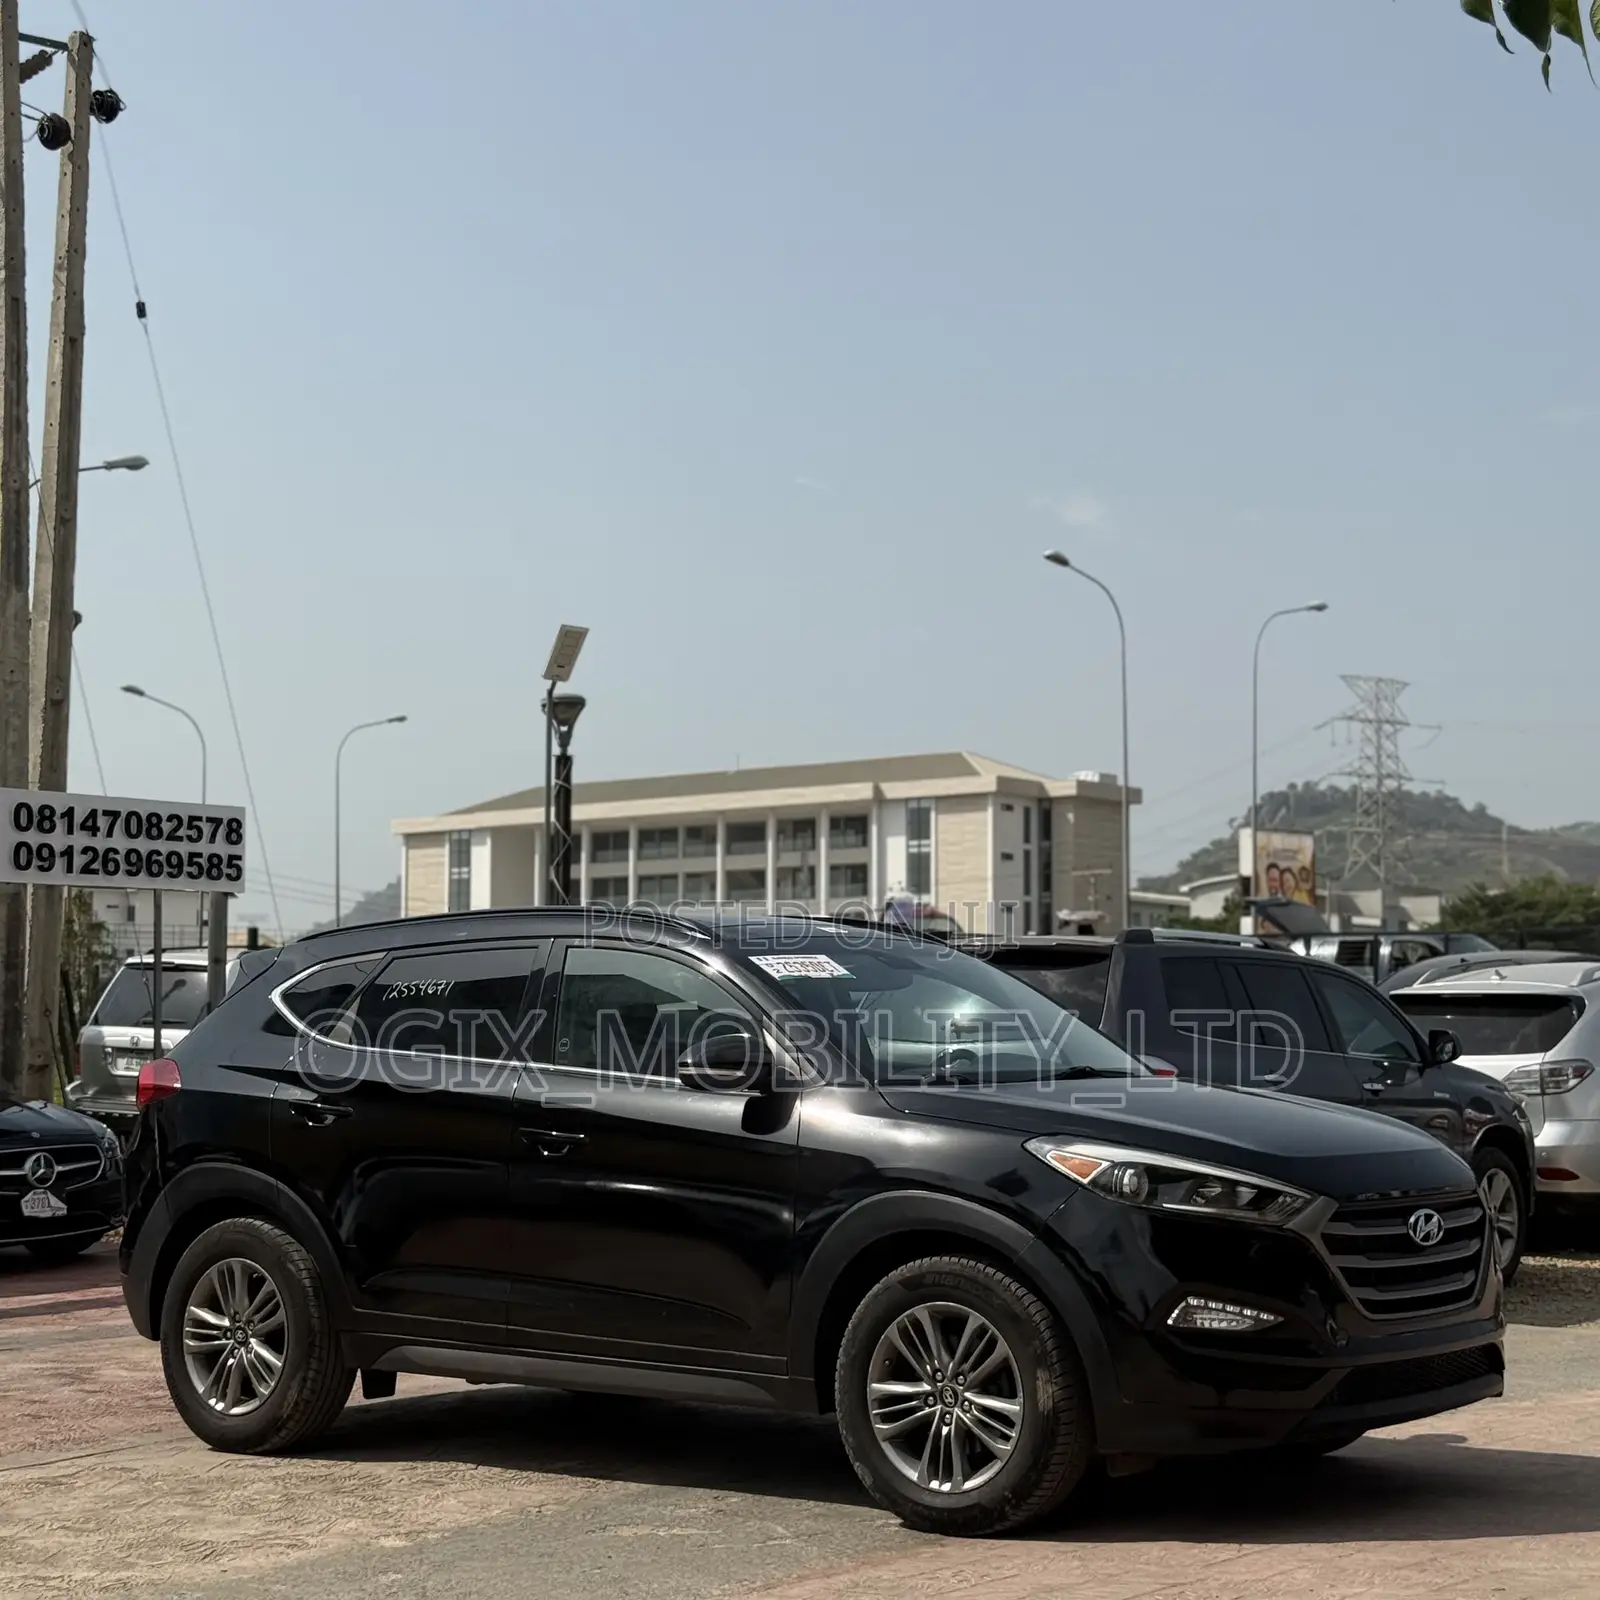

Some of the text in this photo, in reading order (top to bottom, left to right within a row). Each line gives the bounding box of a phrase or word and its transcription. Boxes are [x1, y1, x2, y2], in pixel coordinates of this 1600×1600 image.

[13, 802, 243, 846] 08147082578
[13, 841, 243, 882] 09126969585
[382, 979, 455, 1001] 12554671
